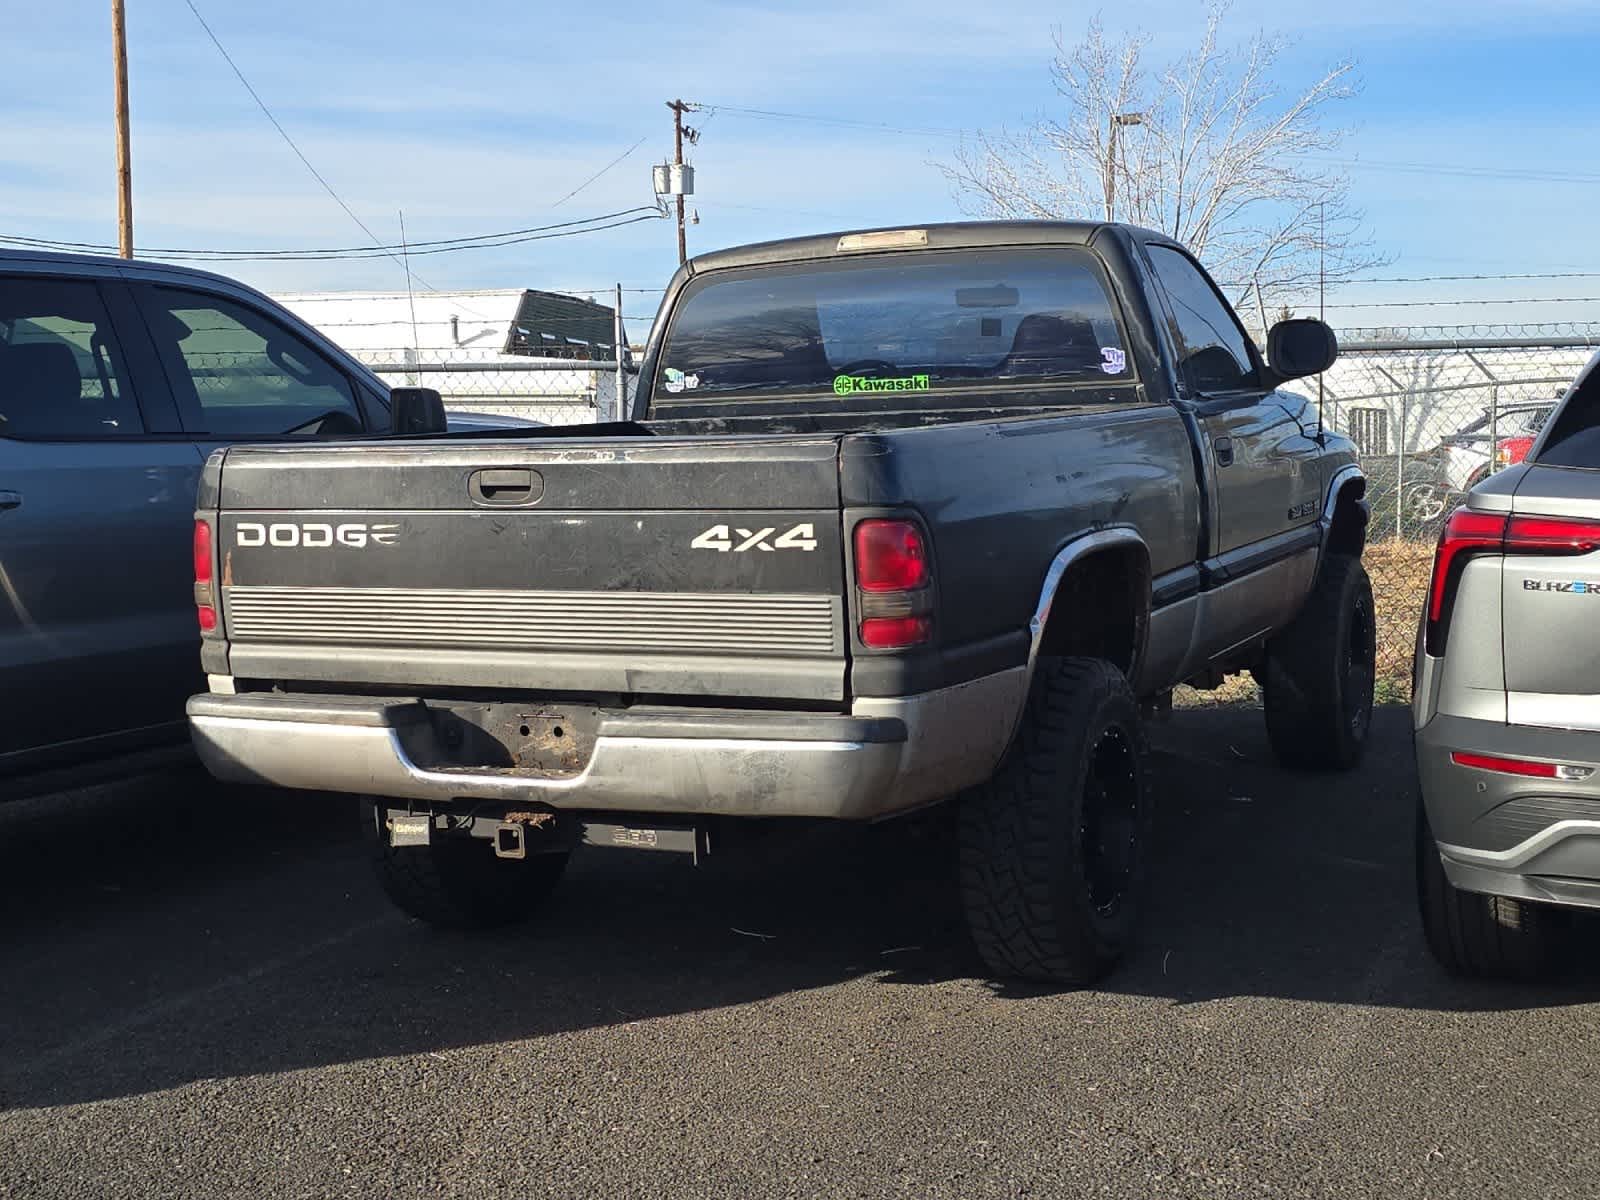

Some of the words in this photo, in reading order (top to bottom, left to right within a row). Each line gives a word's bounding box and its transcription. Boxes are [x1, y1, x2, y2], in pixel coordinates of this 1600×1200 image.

[852, 376, 928, 391] Kawasaki
[236, 523, 401, 548] DODGE
[1523, 579, 1600, 594] BLAZER
